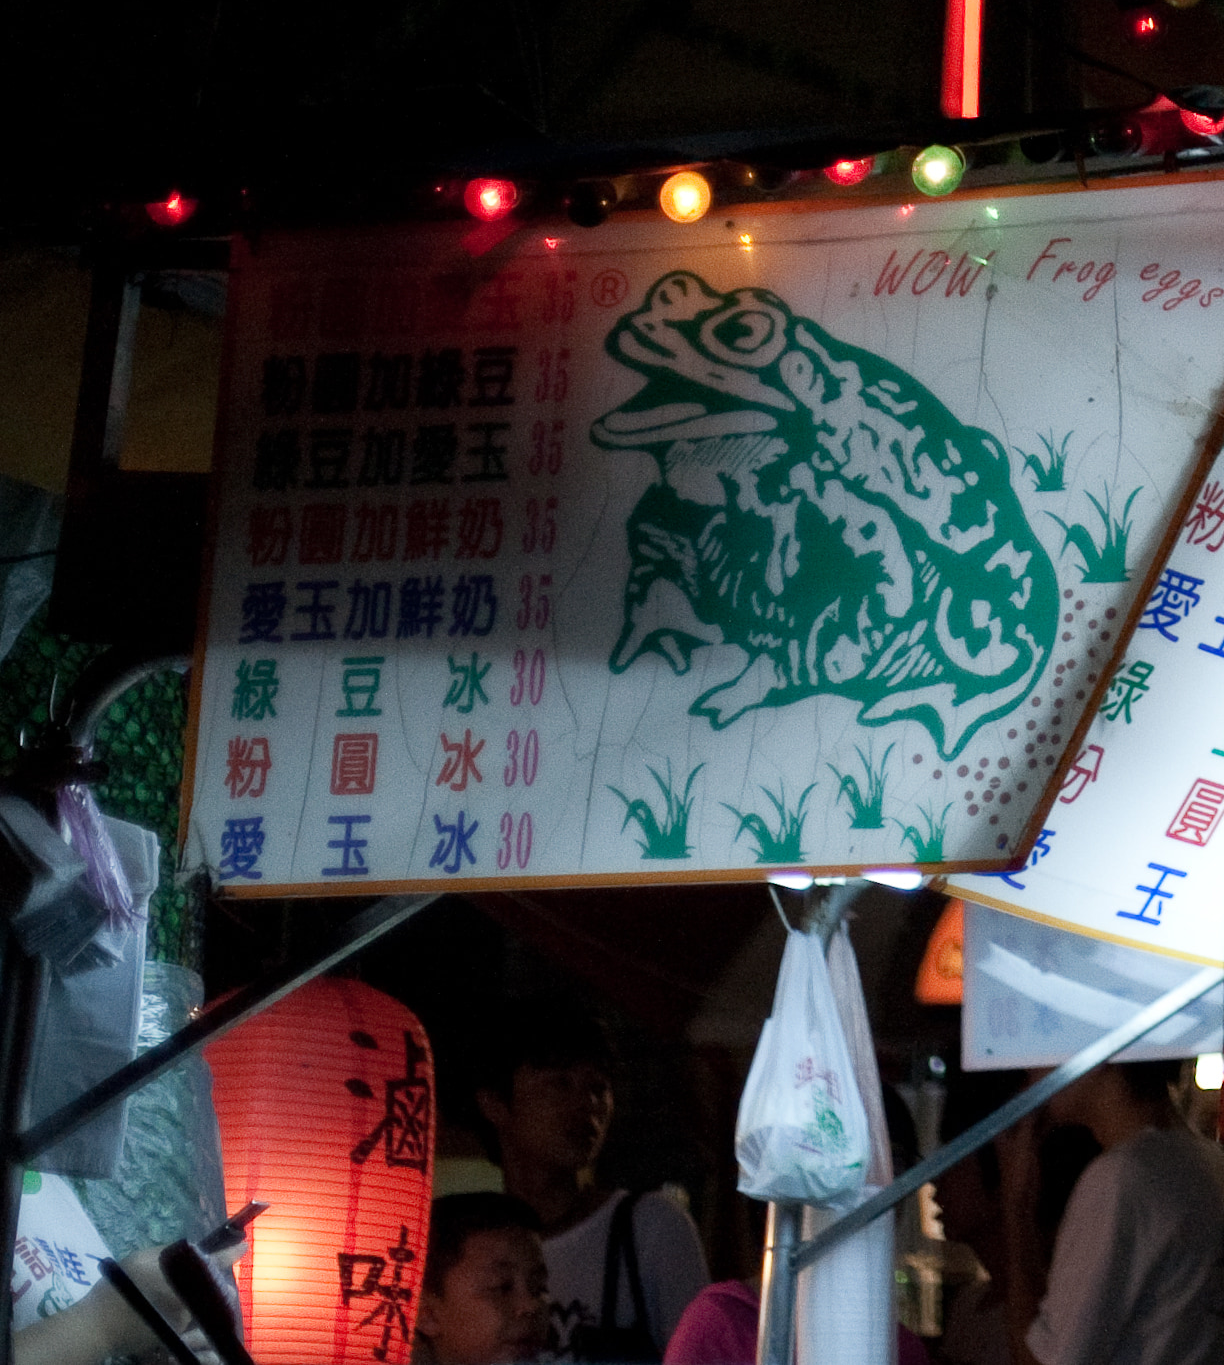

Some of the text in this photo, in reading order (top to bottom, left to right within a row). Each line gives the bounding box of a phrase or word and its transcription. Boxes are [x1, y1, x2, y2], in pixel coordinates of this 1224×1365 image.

[873, 237, 1224, 311] WOW Frog eggs
[534, 348, 570, 403] 35
[529, 420, 564, 476] 35
[247, 497, 558, 566] 粉圓加鮮奶 35
[239, 574, 552, 644] 愛玉加鮮奶 35
[231, 648, 546, 721] 綠豆冰 30
[224, 728, 539, 800] 粉圓冰 30
[219, 811, 533, 880] 愛玉冰 30
